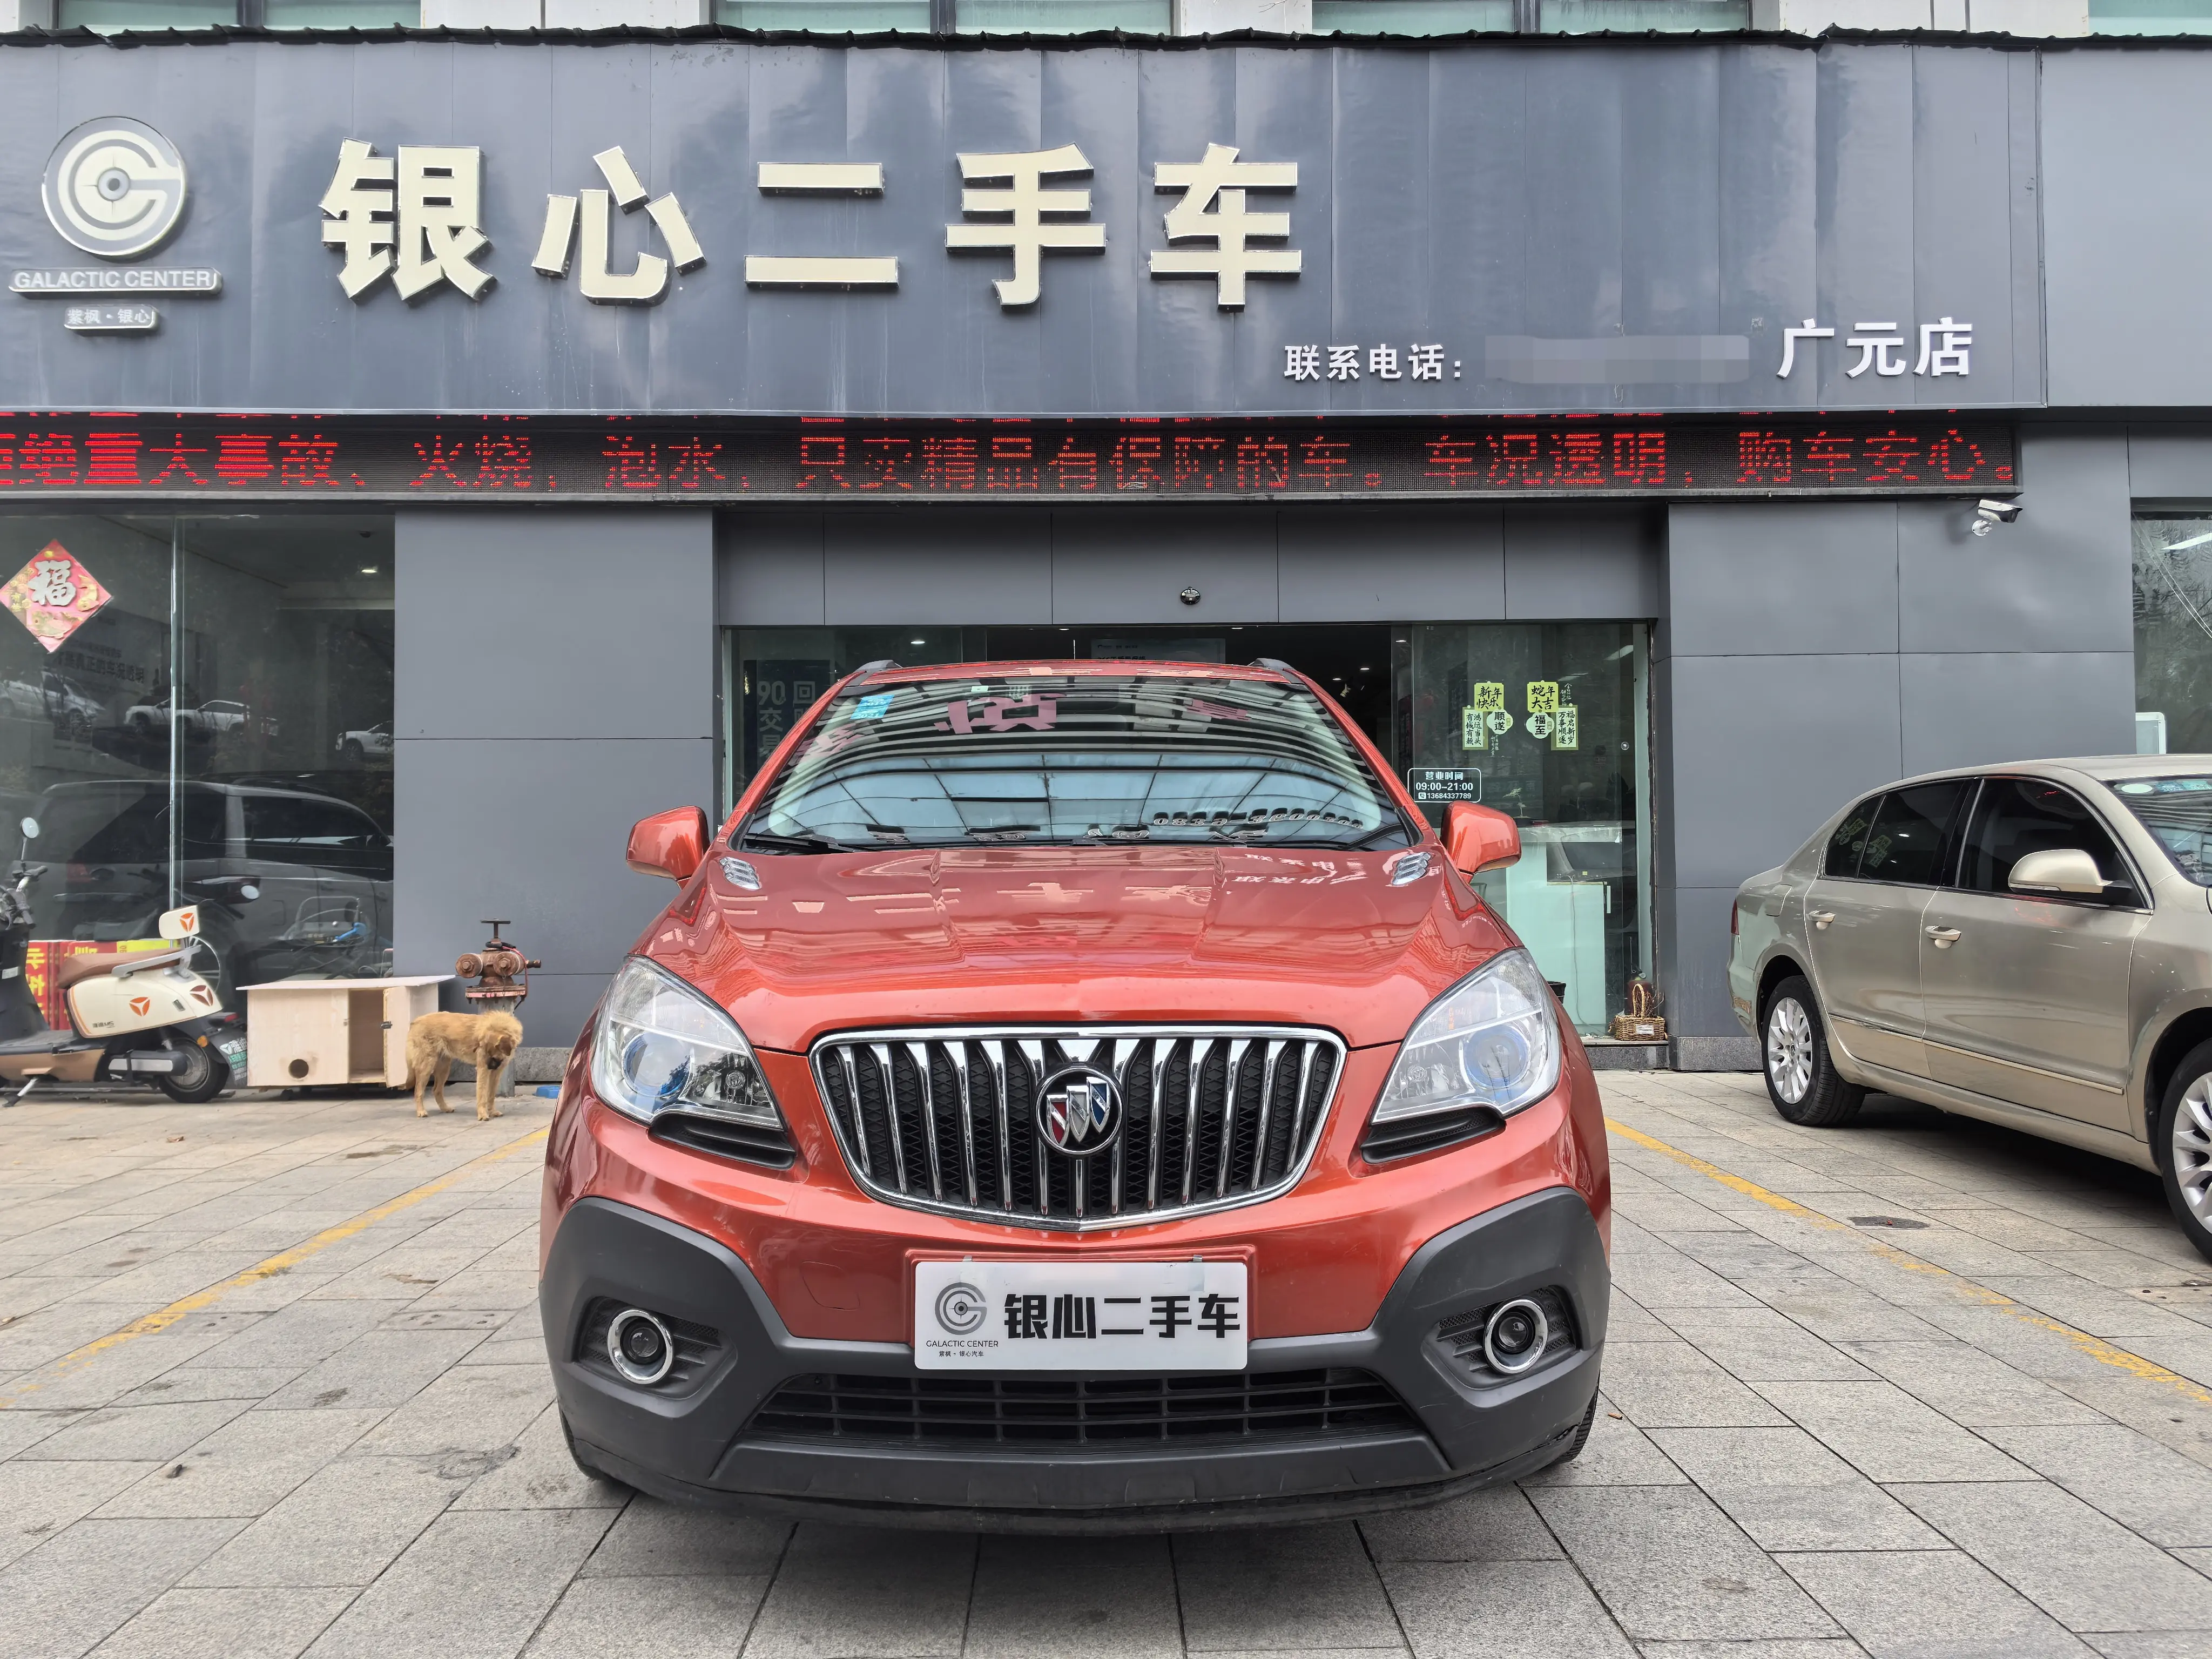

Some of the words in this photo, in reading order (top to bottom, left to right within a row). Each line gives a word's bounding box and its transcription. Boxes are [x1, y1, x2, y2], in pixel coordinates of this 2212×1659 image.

[319, 137, 1302, 308] 银心二手车
[14, 271, 119, 288] GALACTIC
[124, 270, 211, 287] CENTER
[1776, 316, 1973, 378] 广元店
[27, 560, 76, 606] 福
[1478, 686, 1502, 700] 新年
[1531, 685, 1555, 698] 蛇年
[1476, 697, 1499, 710] 快乐
[1532, 697, 1554, 710] 大吉
[1494, 711, 1506, 731] 顺遂
[1535, 715, 1546, 735] 福至
[1558, 711, 1567, 744] 万事顺遂
[1566, 710, 1575, 745] 福启新岁
[1425, 771, 1464, 780] 营业时间
[1004, 1293, 1240, 1339] 银心二手车
